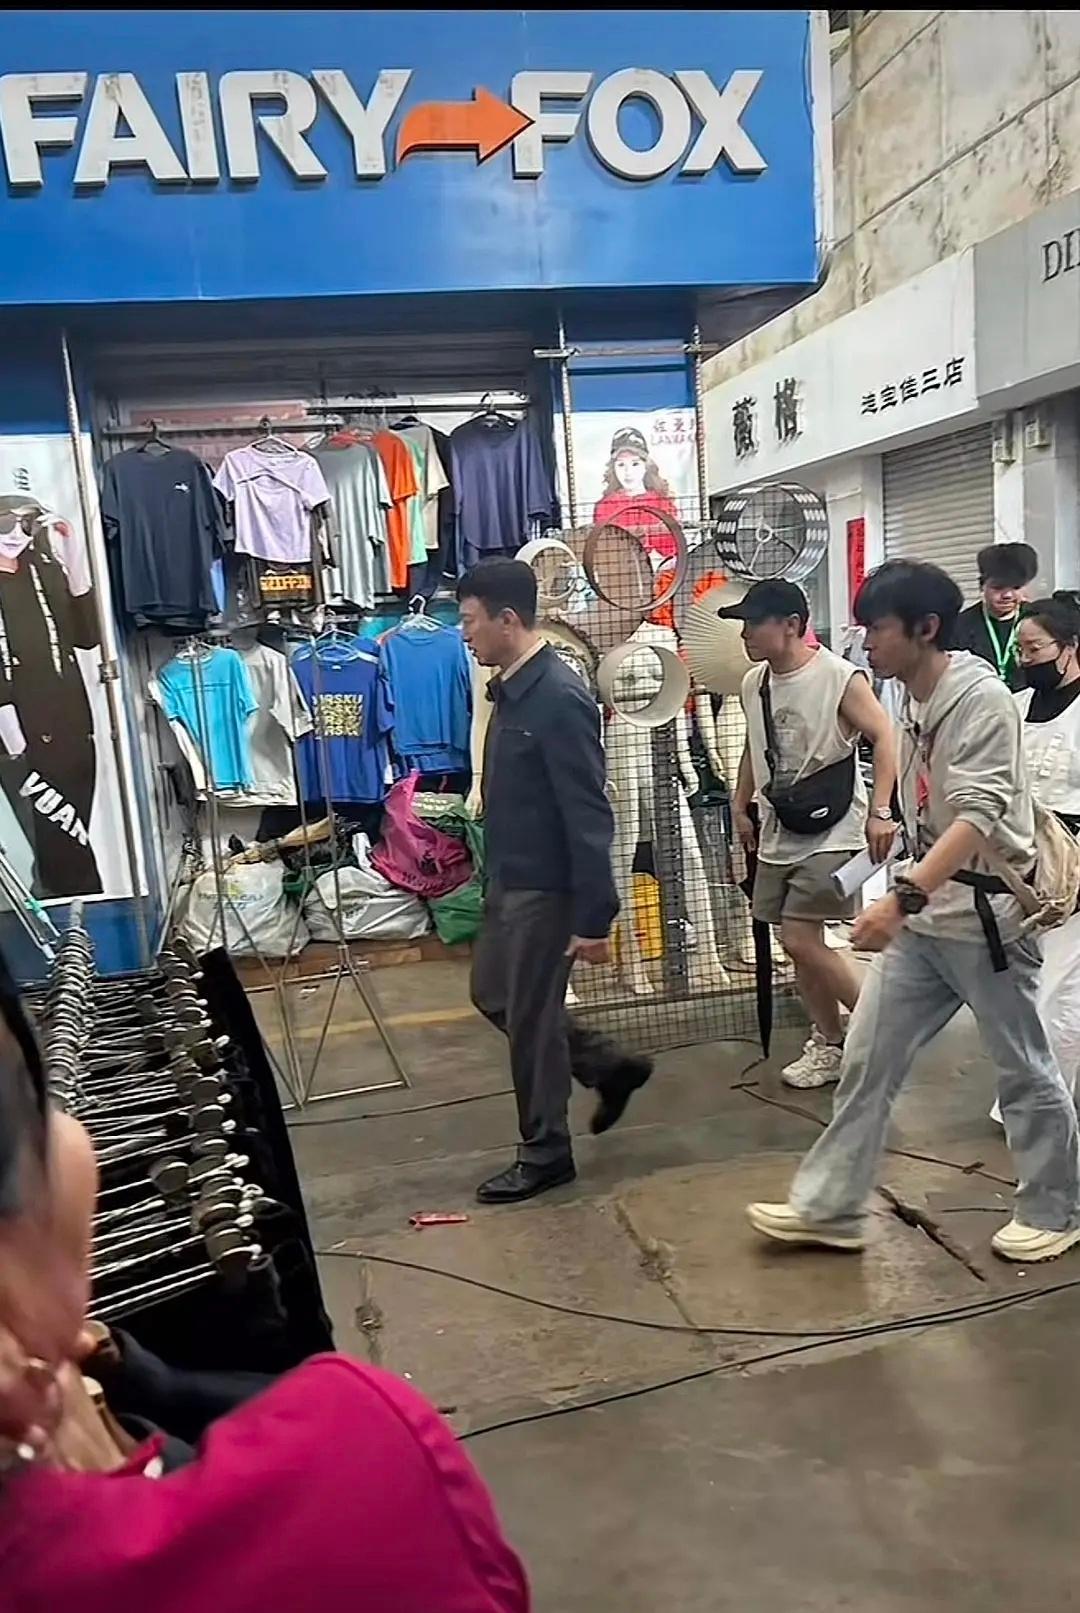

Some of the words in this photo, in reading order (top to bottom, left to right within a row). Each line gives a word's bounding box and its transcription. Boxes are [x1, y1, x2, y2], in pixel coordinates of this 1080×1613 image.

[0, 68, 412, 188] FAIRY
[511, 67, 768, 181] FOX
[1041, 228, 1080, 283] DI
